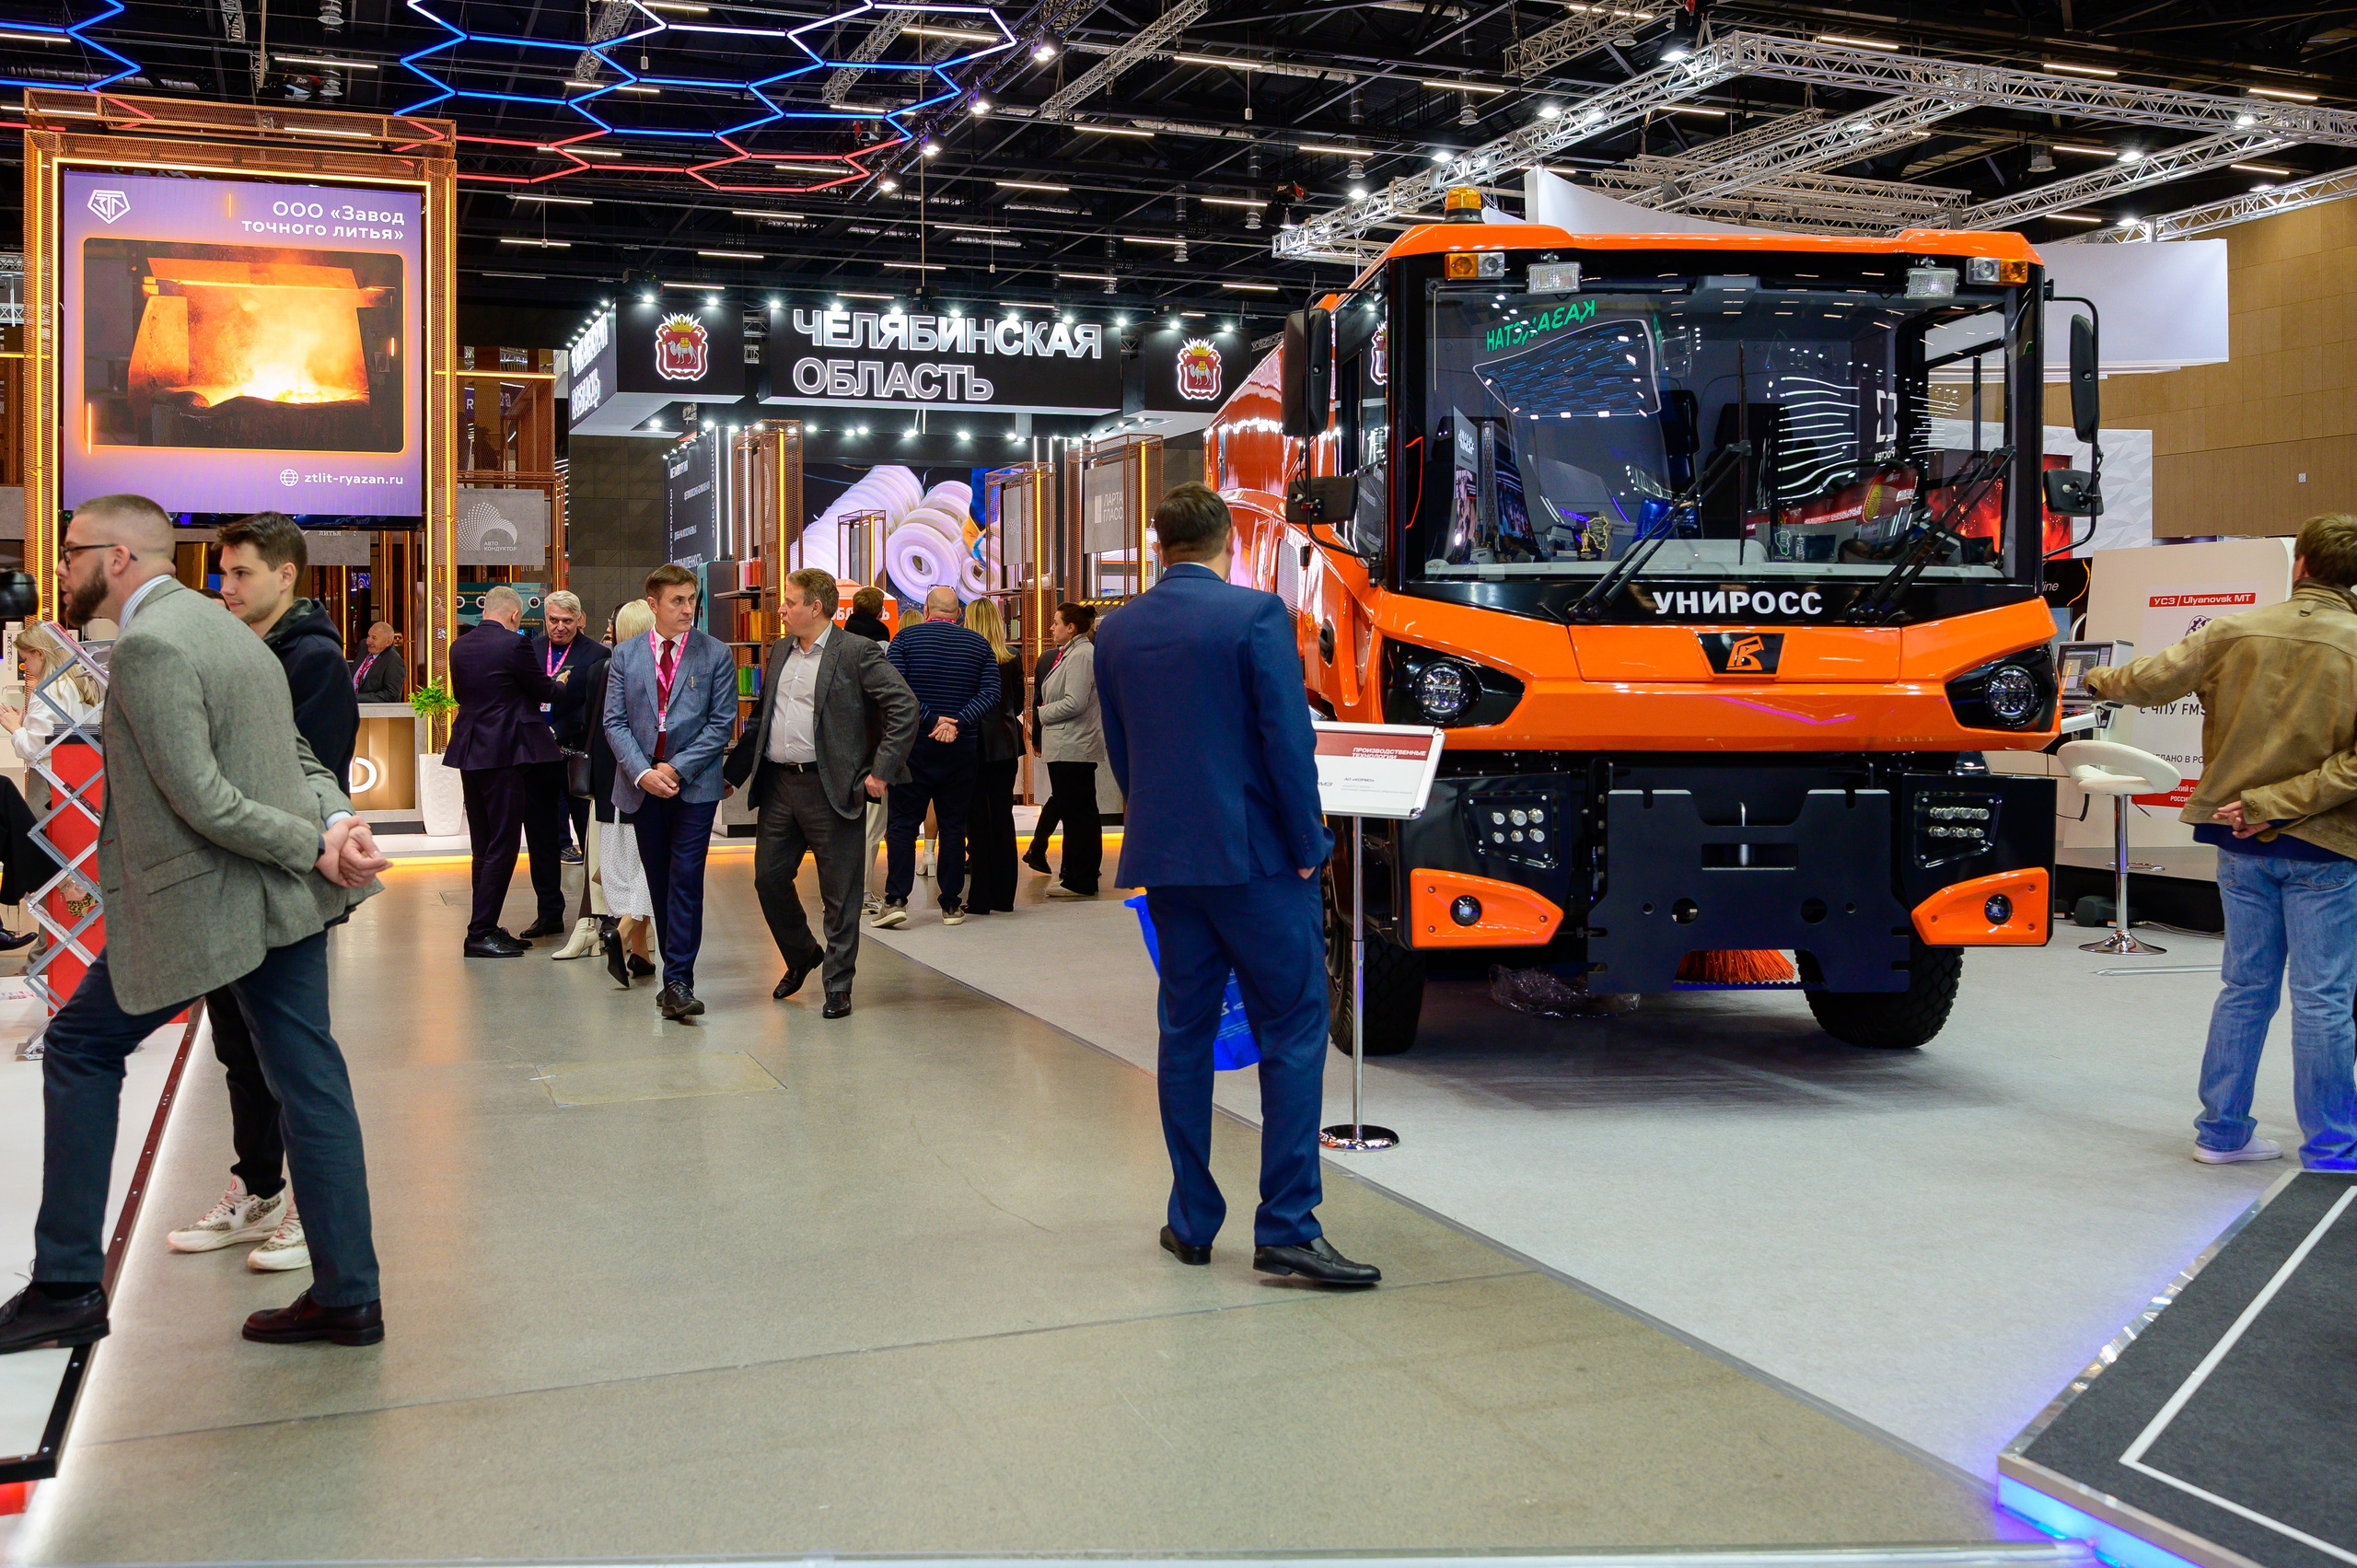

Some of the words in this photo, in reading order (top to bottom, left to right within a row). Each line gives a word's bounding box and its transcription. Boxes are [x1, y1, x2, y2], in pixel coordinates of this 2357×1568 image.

[273, 201, 324, 219] ООО
[331, 204, 405, 226] «Завод
[241, 219, 328, 237] точного
[331, 225, 405, 241] литья»
[793, 308, 1102, 359] ЧЕЛЯБИНСКАЯ
[793, 356, 994, 401] ОБЛАСТЬ
[304, 471, 403, 486] ztlit-ryazan.ru
[1103, 491, 1123, 506] ЛАРТА
[1103, 506, 1124, 522] ГЛАСС
[1652, 590, 1823, 615] УНИРОСС
[2183, 595, 2233, 606] Ulyanovsk
[2234, 594, 2252, 603] MT
[1353, 747, 1426, 757] ПРОИЗВОДСТВЕННЫЕ
[2184, 755, 2190, 763] В
